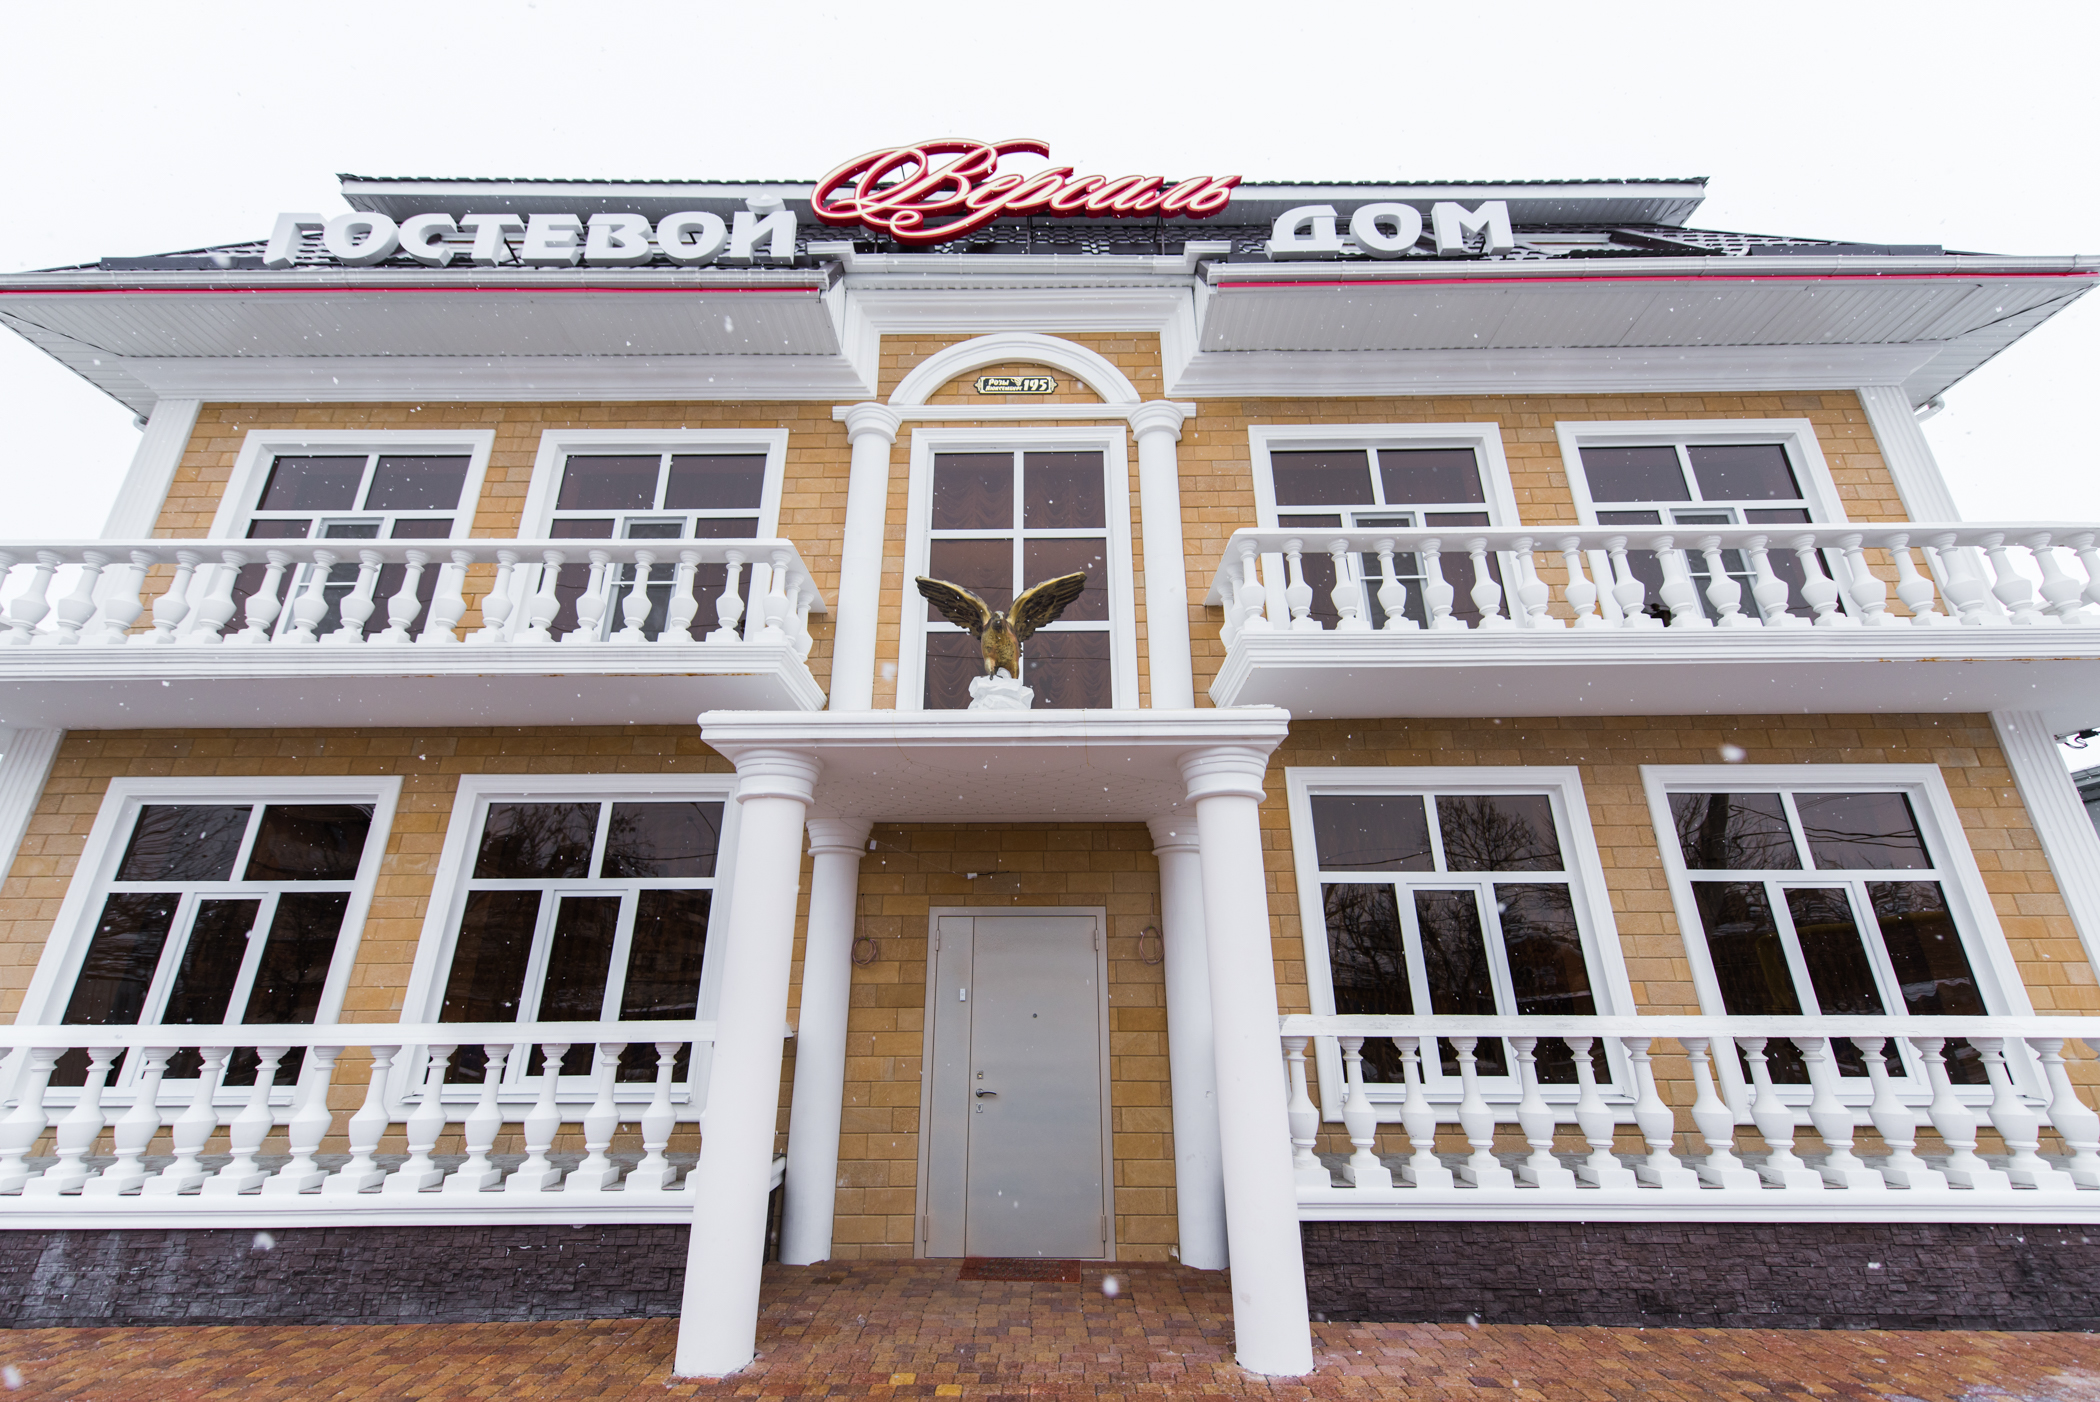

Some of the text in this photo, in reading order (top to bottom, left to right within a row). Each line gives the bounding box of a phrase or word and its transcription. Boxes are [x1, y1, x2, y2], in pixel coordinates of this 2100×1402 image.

[262, 137, 1515, 269] ГОСТЕВОЙ Версаль ДОМ
[988, 378, 1010, 386] Розы
[1023, 379, 1048, 391] 195
